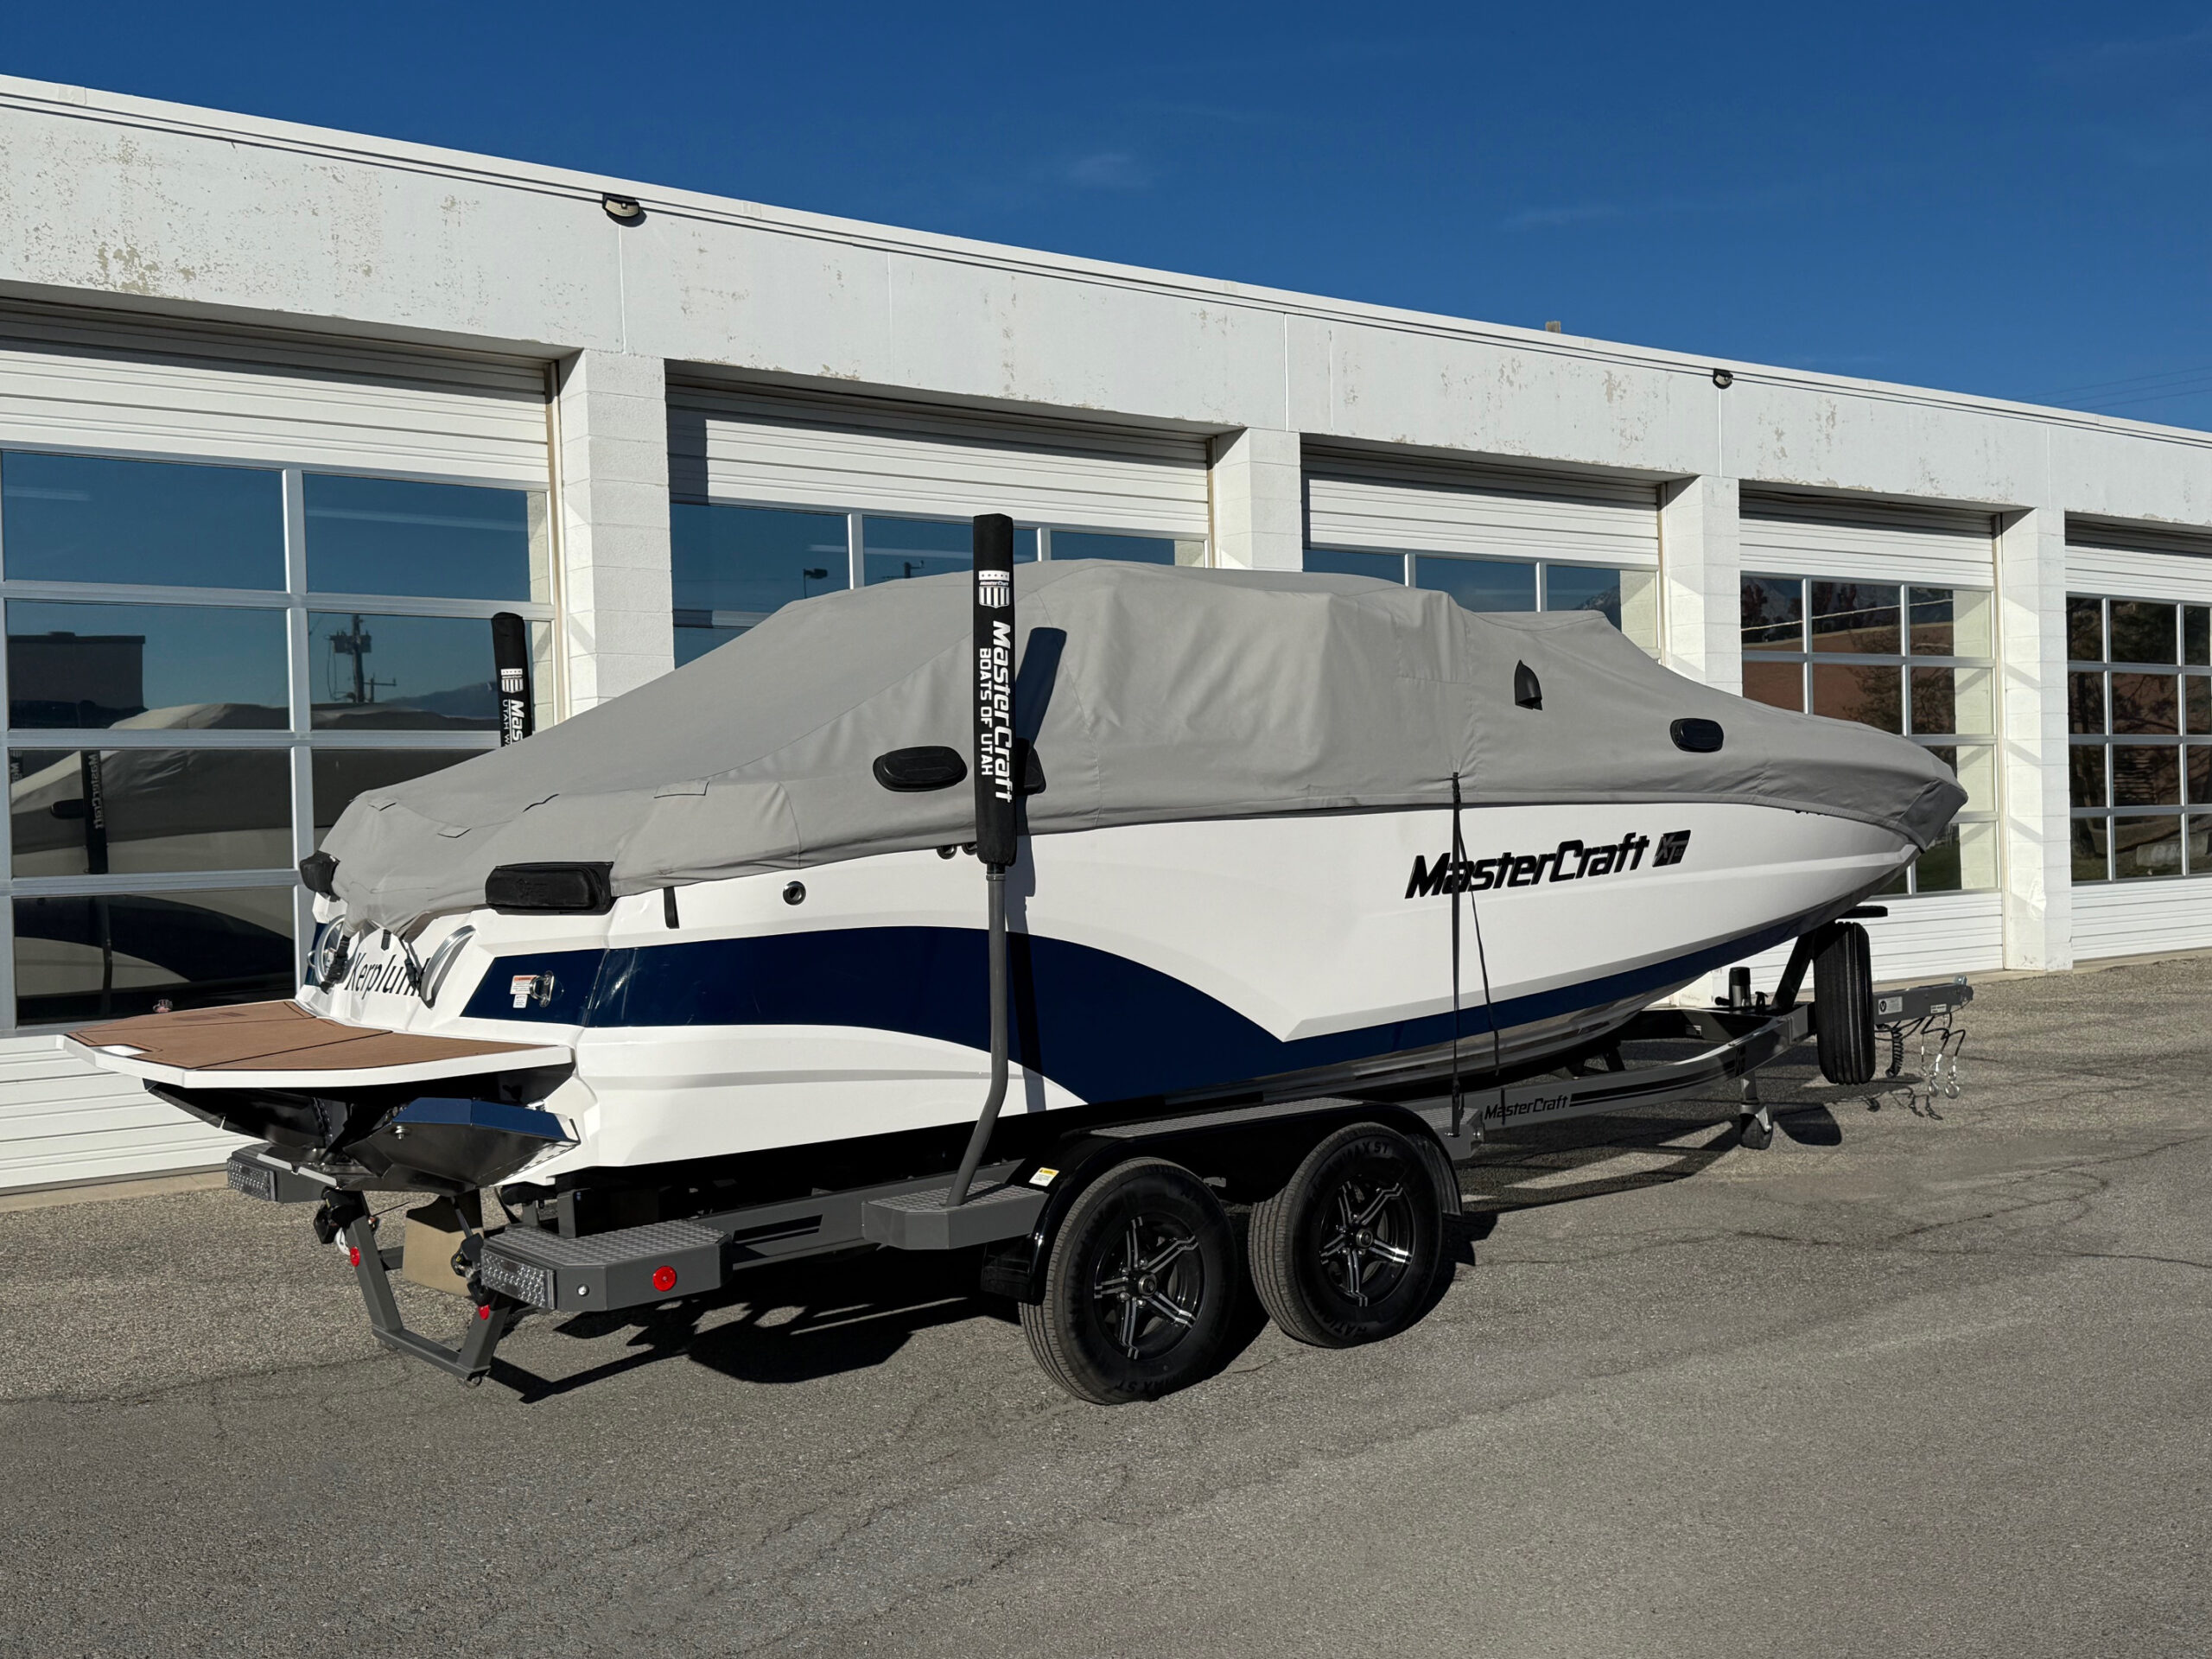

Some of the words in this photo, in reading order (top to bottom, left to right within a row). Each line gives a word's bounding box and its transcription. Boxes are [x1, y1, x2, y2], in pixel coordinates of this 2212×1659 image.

[979, 648, 992, 702] BOATS
[980, 706, 992, 728] OF
[992, 620, 1013, 803] MasterCraft
[981, 733, 993, 776] UTAH
[1404, 831, 1650, 899] MasterCraft
[1484, 1095, 1568, 1121] MasterCraft
